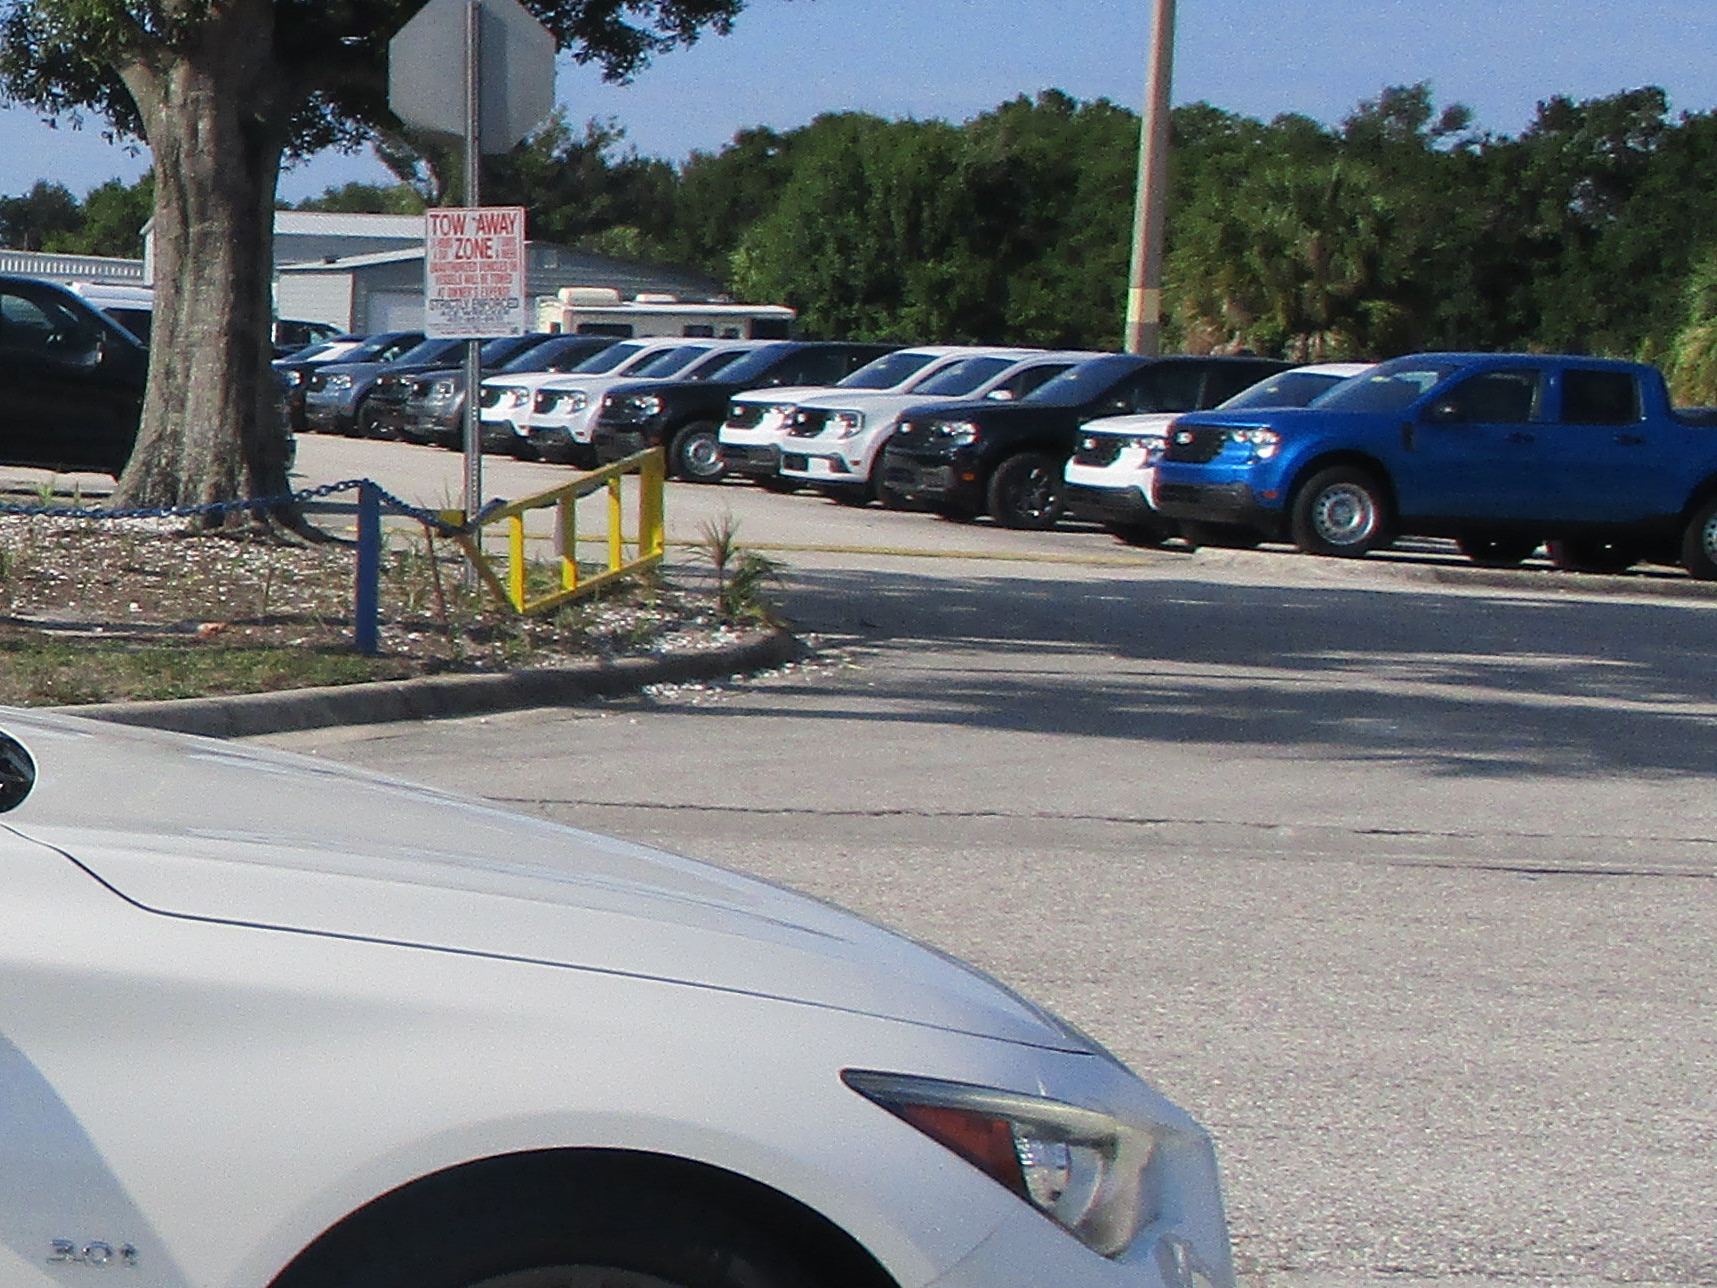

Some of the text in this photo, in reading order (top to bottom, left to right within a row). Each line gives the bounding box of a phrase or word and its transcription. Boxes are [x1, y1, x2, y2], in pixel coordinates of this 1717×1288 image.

[429, 213, 517, 236] TOW AWAY
[454, 237, 493, 260] ZONE
